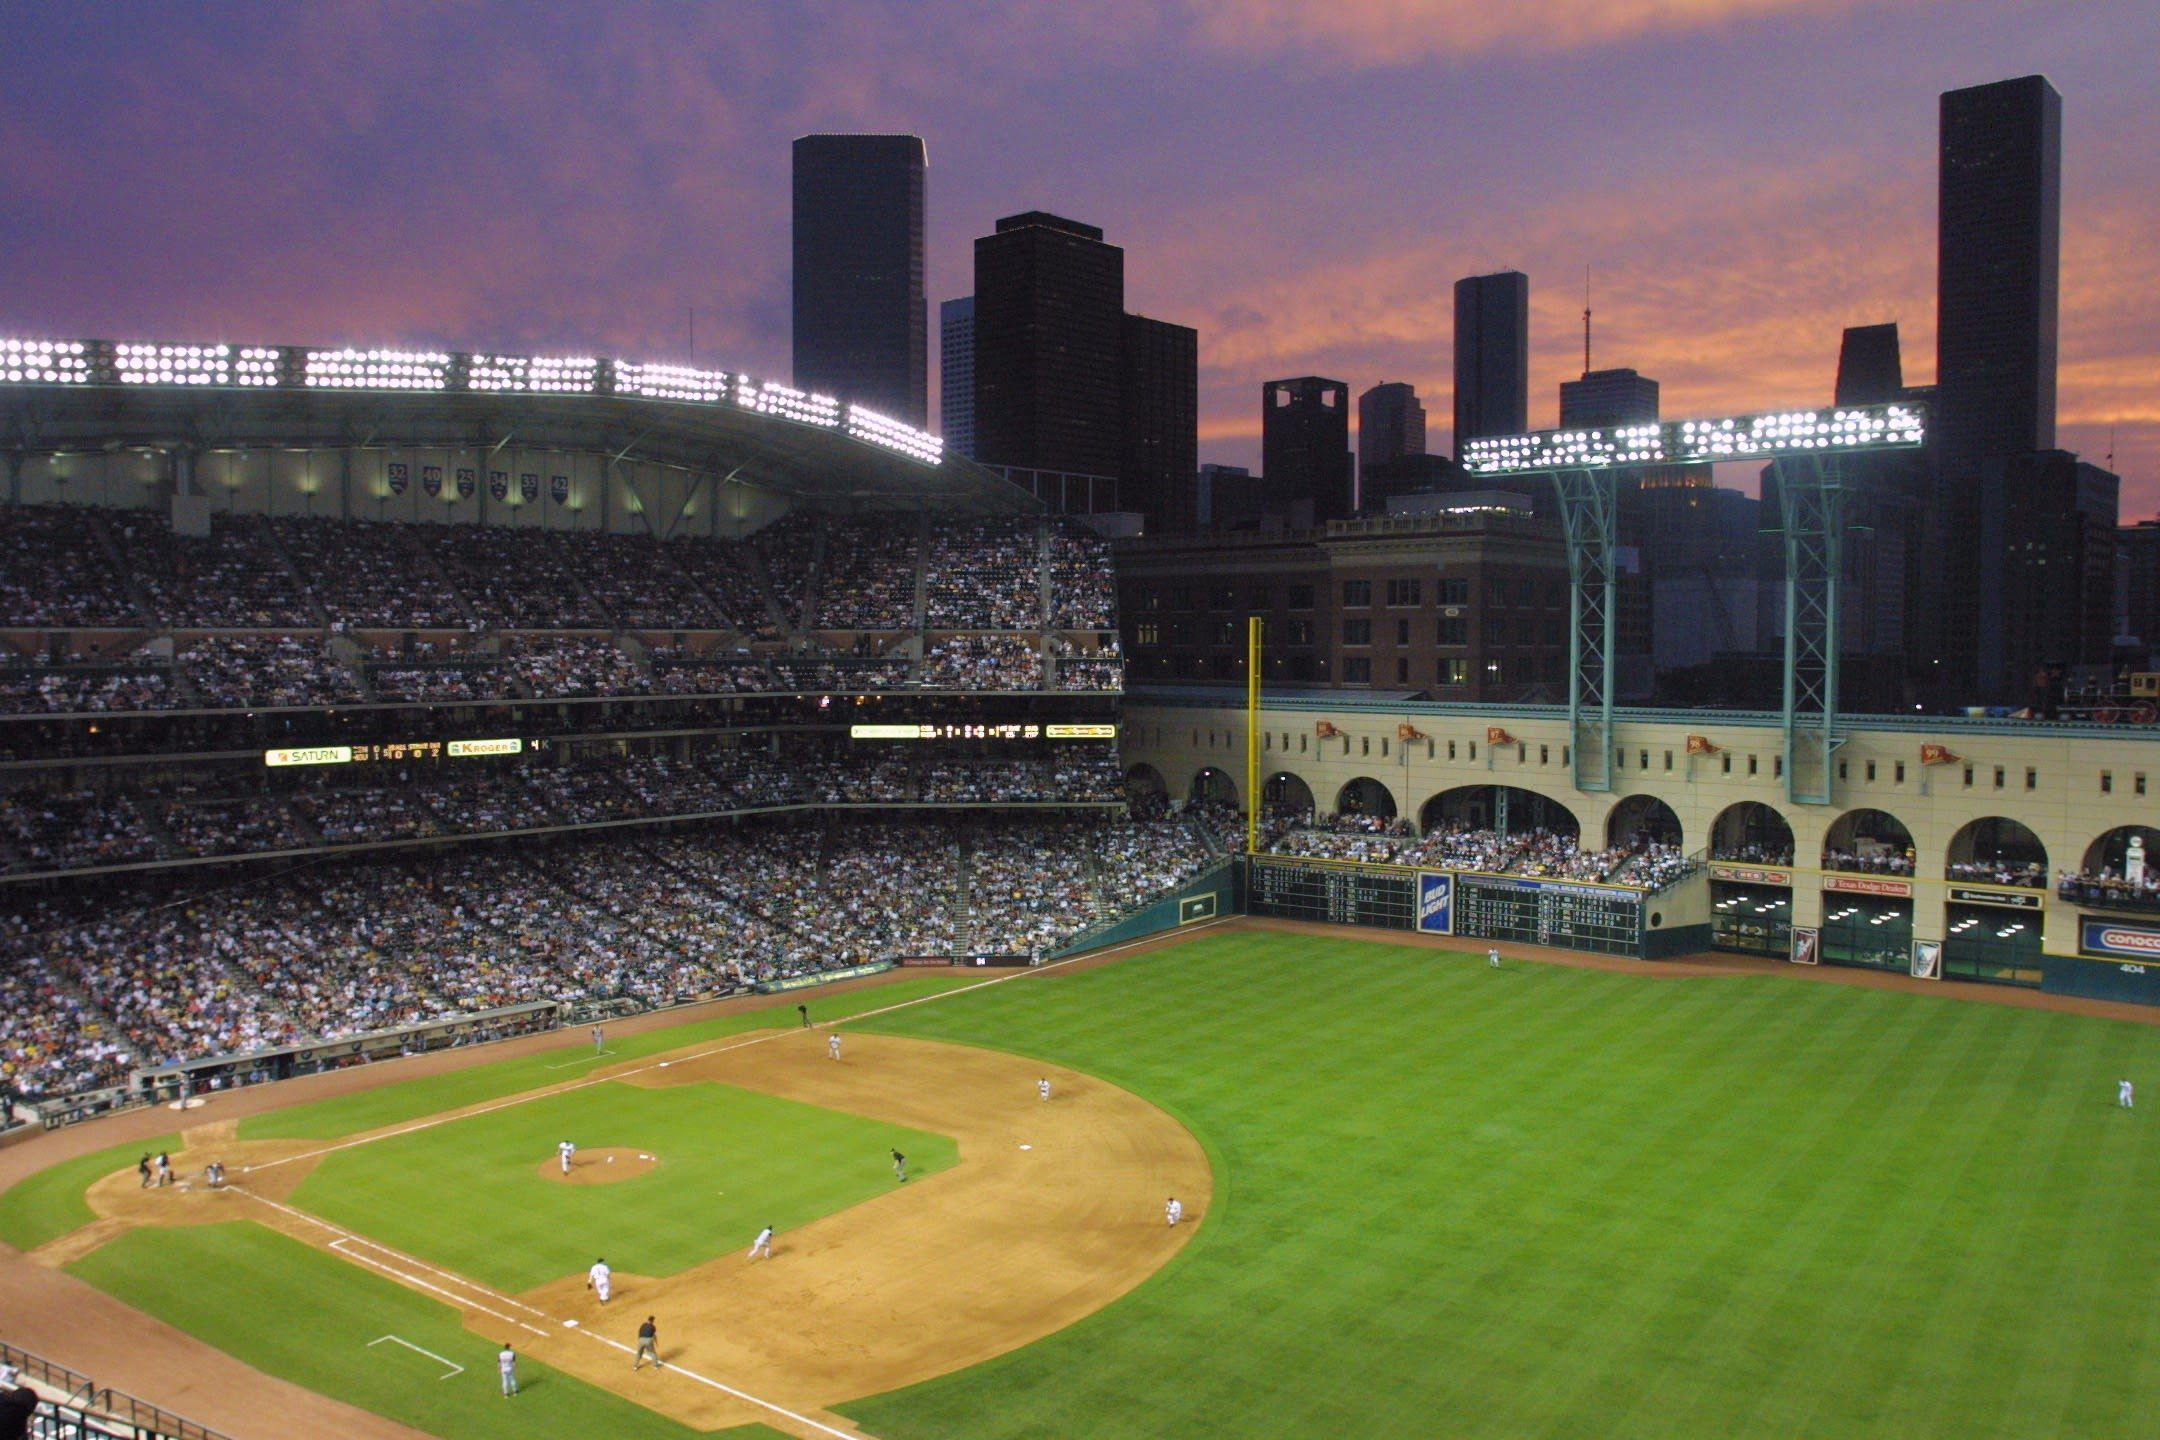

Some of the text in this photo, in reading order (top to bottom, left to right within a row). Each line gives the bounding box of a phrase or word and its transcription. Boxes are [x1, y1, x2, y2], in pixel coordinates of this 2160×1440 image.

[390, 465, 406, 478] 32
[423, 467, 441, 480] 40
[458, 470, 474, 482] 25
[491, 473, 507, 485] 34
[522, 475, 537, 488] 33
[554, 478, 568, 490] 42
[462, 743, 508, 754] KROGER
[531, 740, 539, 750] 4
[292, 750, 339, 762] SATURN
[1837, 879, 1857, 889] Texas
[1857, 882, 1880, 893] Dodge
[1424, 884, 1446, 904] BUD
[1421, 895, 1449, 919] LIGHT
[2120, 964, 2145, 974] 404
